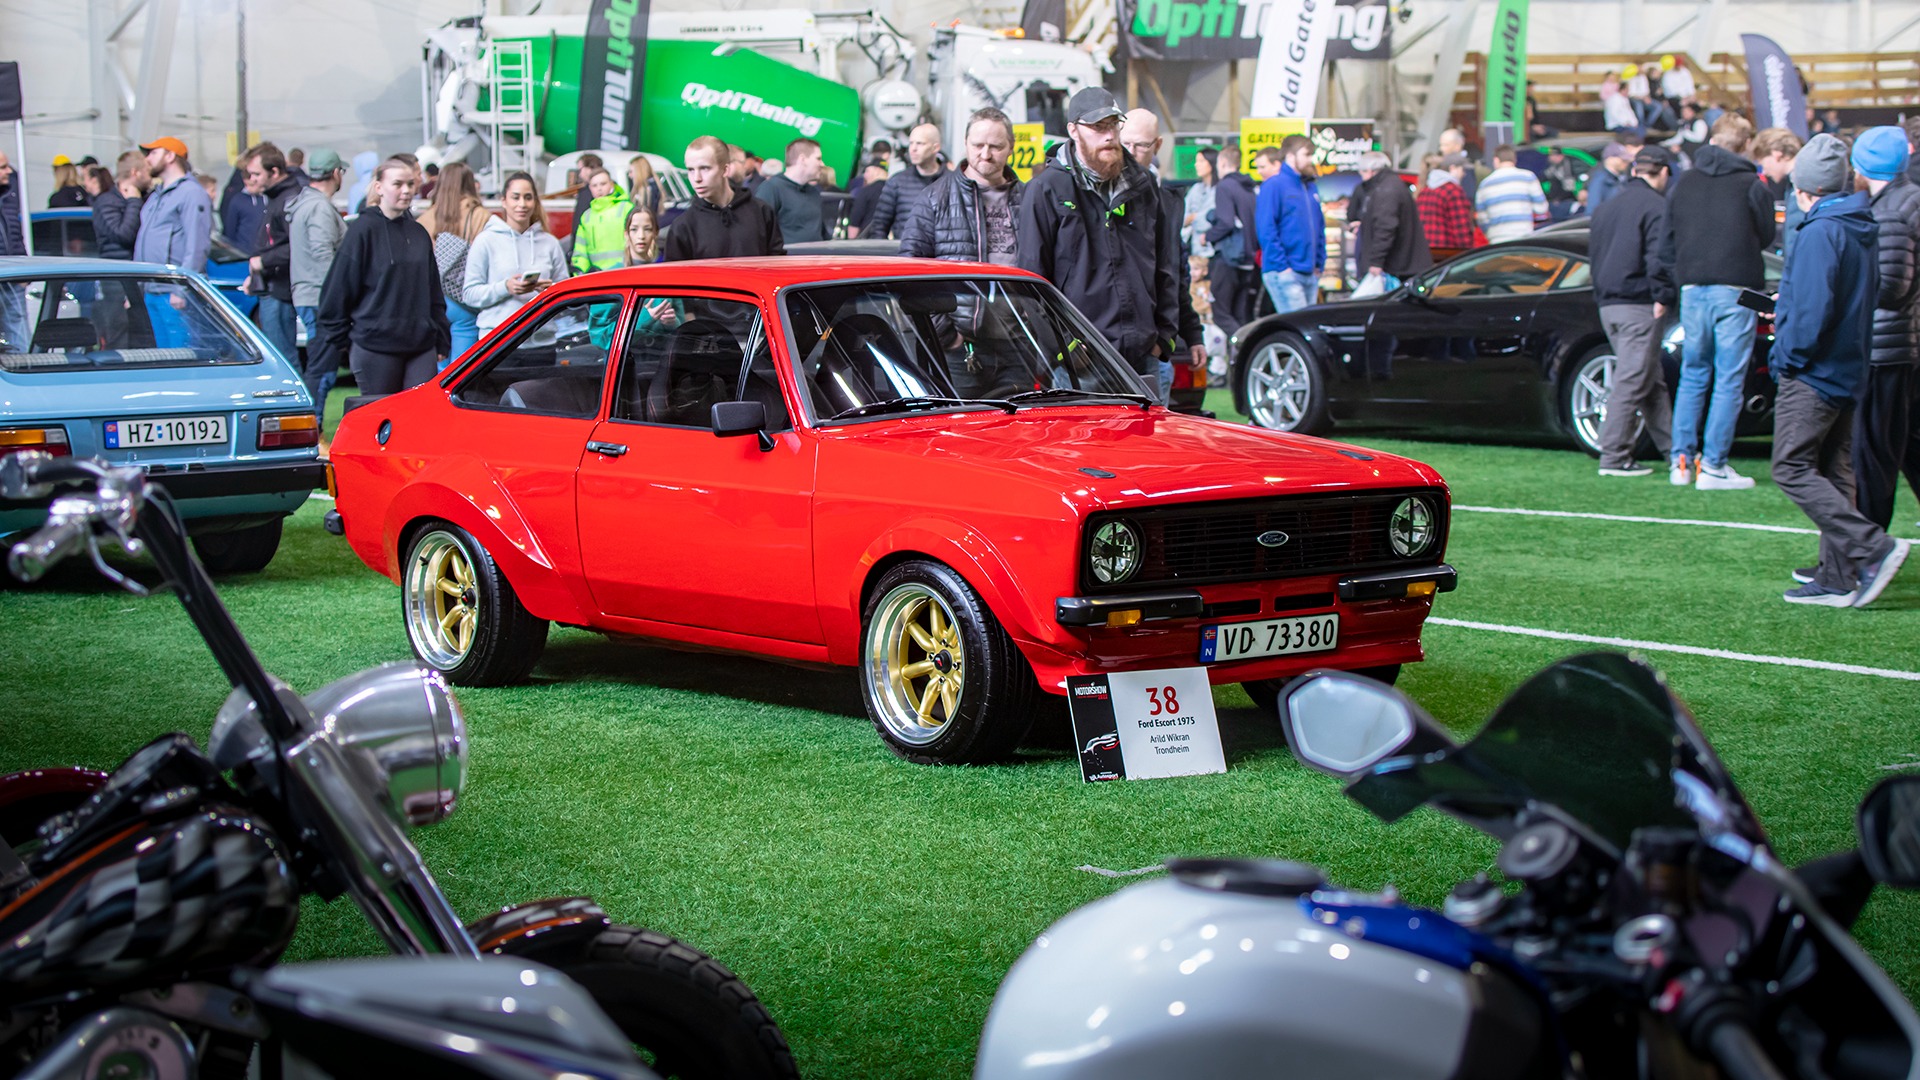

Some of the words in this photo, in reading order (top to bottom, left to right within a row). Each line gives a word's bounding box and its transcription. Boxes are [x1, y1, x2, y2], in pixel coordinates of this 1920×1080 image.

[680, 82, 823, 137] OptiTuning
[127, 422, 155, 444] HZ
[165, 419, 222, 442] 10192
[1263, 534, 1284, 543] Ford
[1223, 626, 1254, 656] VD
[1265, 618, 1335, 652] 73380
[1204, 647, 1213, 657] N
[1074, 685, 1107, 697] MOTORSHOW
[1145, 685, 1180, 716] 38
[1138, 719, 1155, 729] Ford
[1154, 718, 1176, 728] Escort
[1176, 716, 1196, 726] 1975
[1149, 734, 1166, 744] Arild
[1165, 733, 1191, 743] Wikran
[1154, 744, 1190, 755] Trondheim
